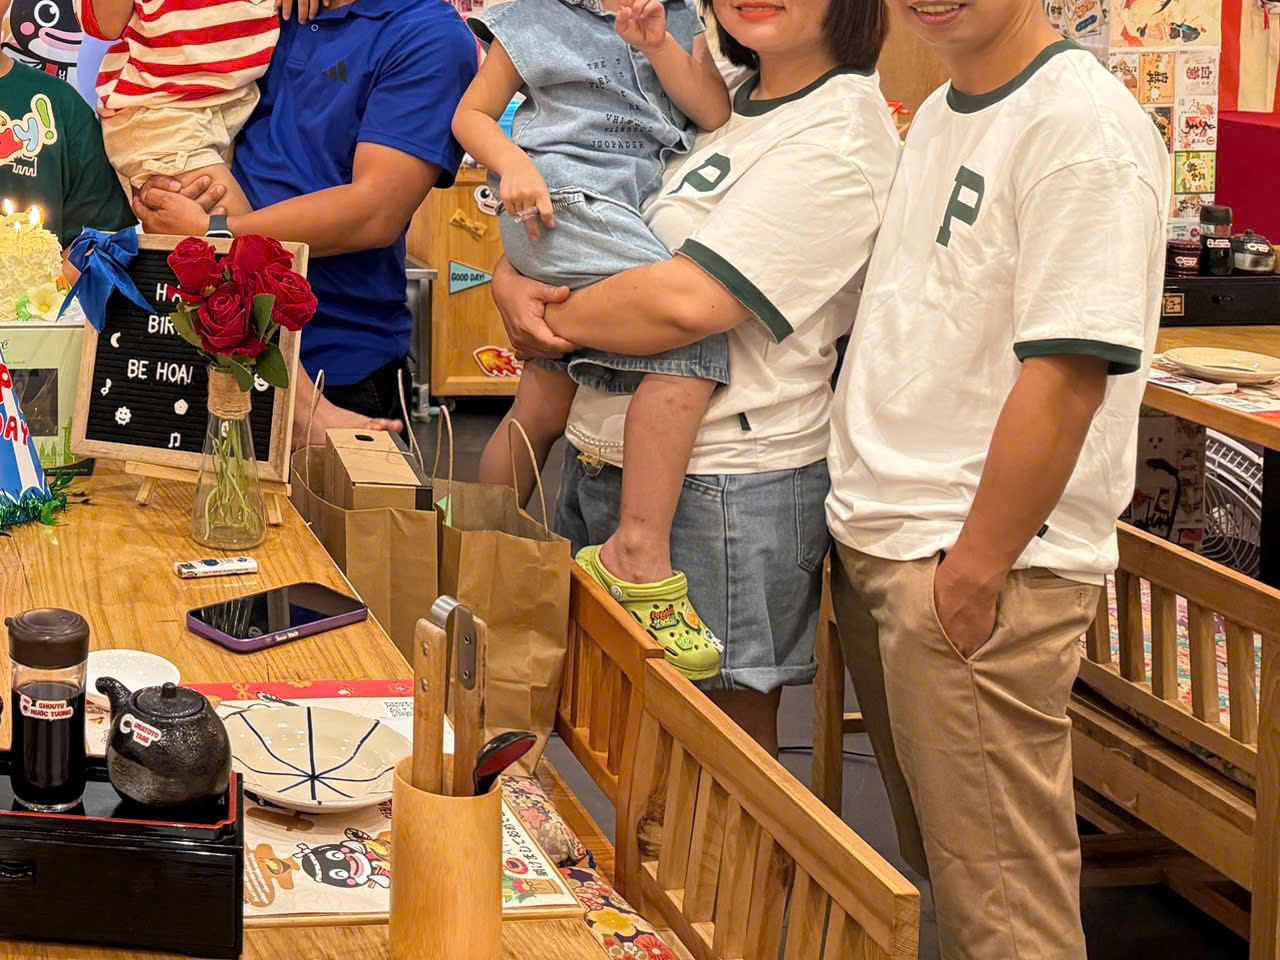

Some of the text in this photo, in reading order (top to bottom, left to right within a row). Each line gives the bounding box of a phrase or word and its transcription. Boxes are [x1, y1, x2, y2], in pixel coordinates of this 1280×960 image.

[936, 164, 989, 247] P
[451, 272, 469, 282] GOOD
[127, 359, 150, 380] BE
